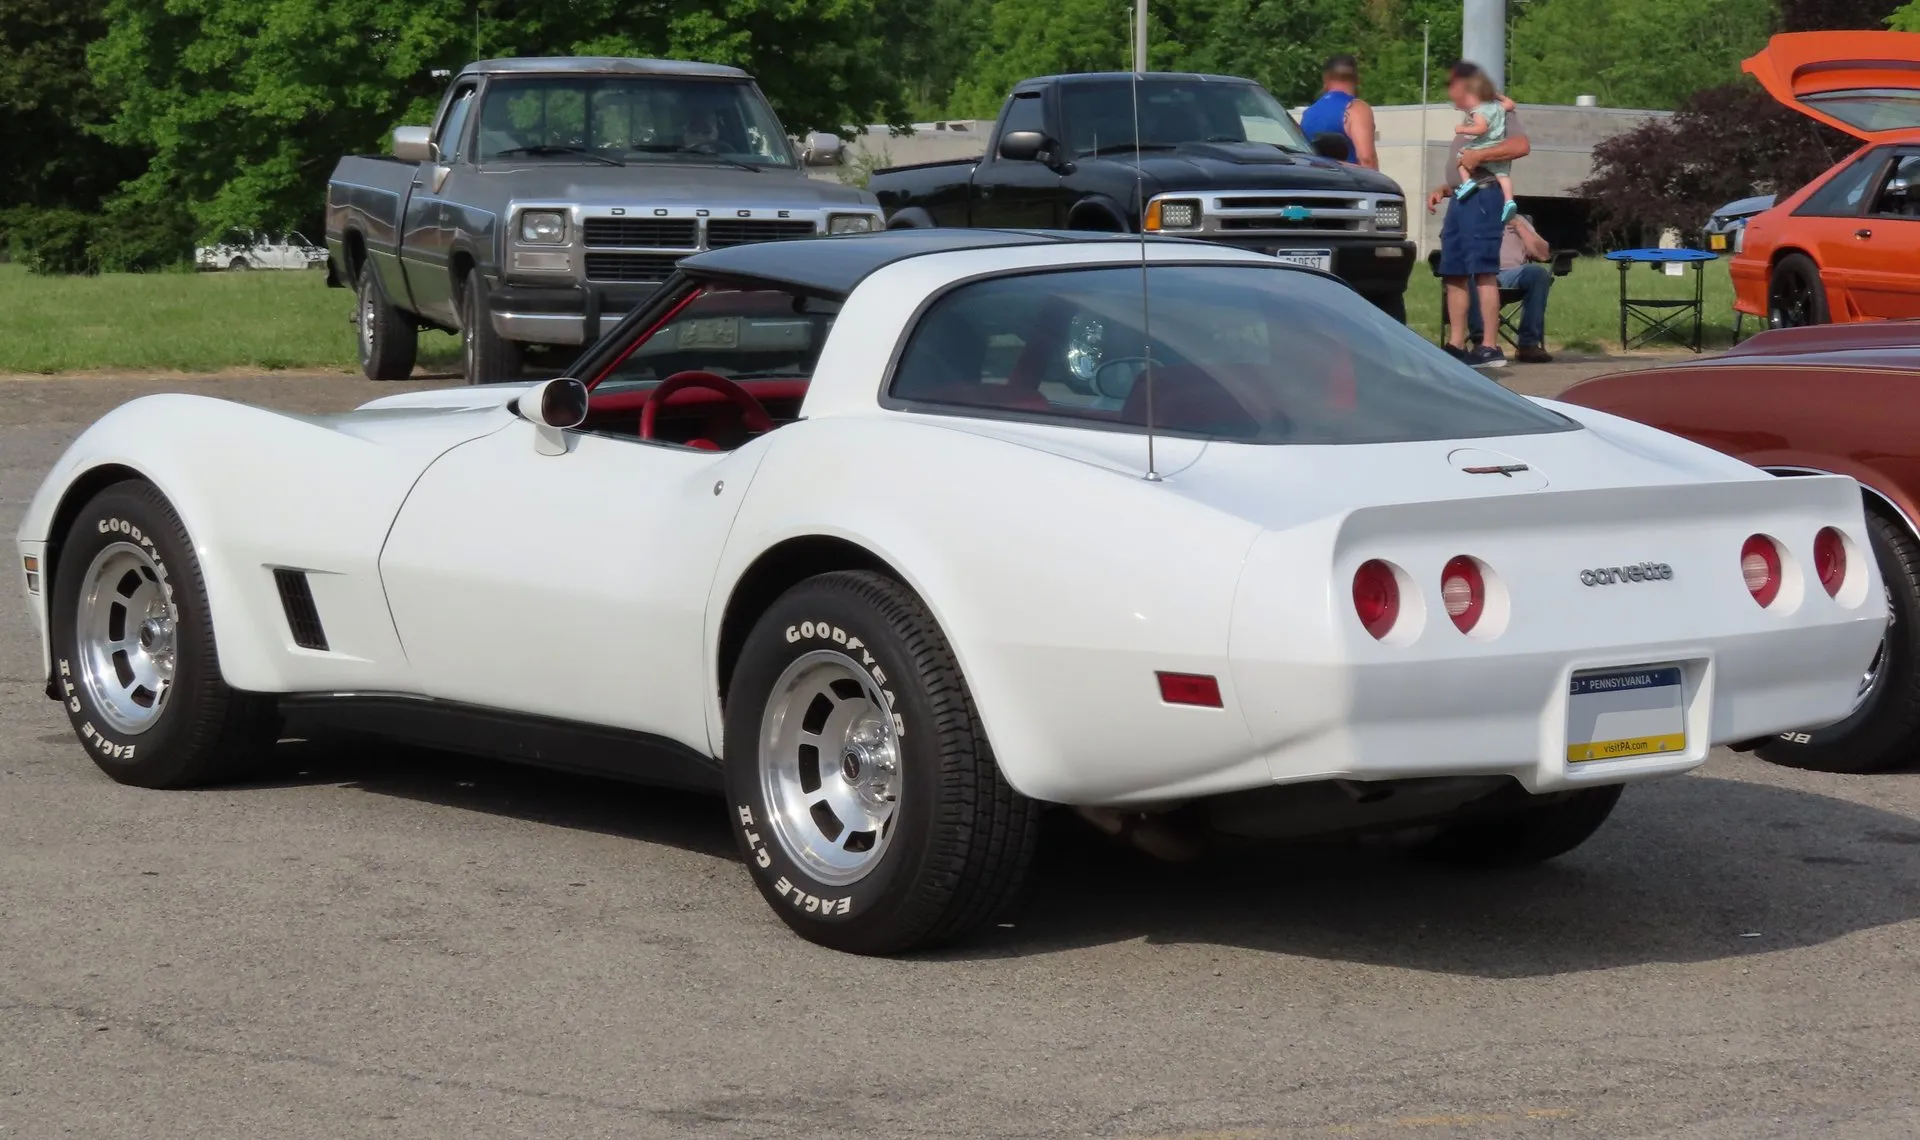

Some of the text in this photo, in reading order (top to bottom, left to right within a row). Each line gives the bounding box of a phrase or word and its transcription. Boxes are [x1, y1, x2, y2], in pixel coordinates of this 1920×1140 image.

[611, 208, 790, 218] DODGE
[1580, 561, 1673, 586] corvette
[785, 621, 905, 737] GOODYEAR
[1589, 675, 1652, 690] PENNSYLVANIA
[82, 721, 135, 759] EAGLE
[1603, 741, 1648, 753] visitPA.com
[774, 874, 852, 916] EAGLE
